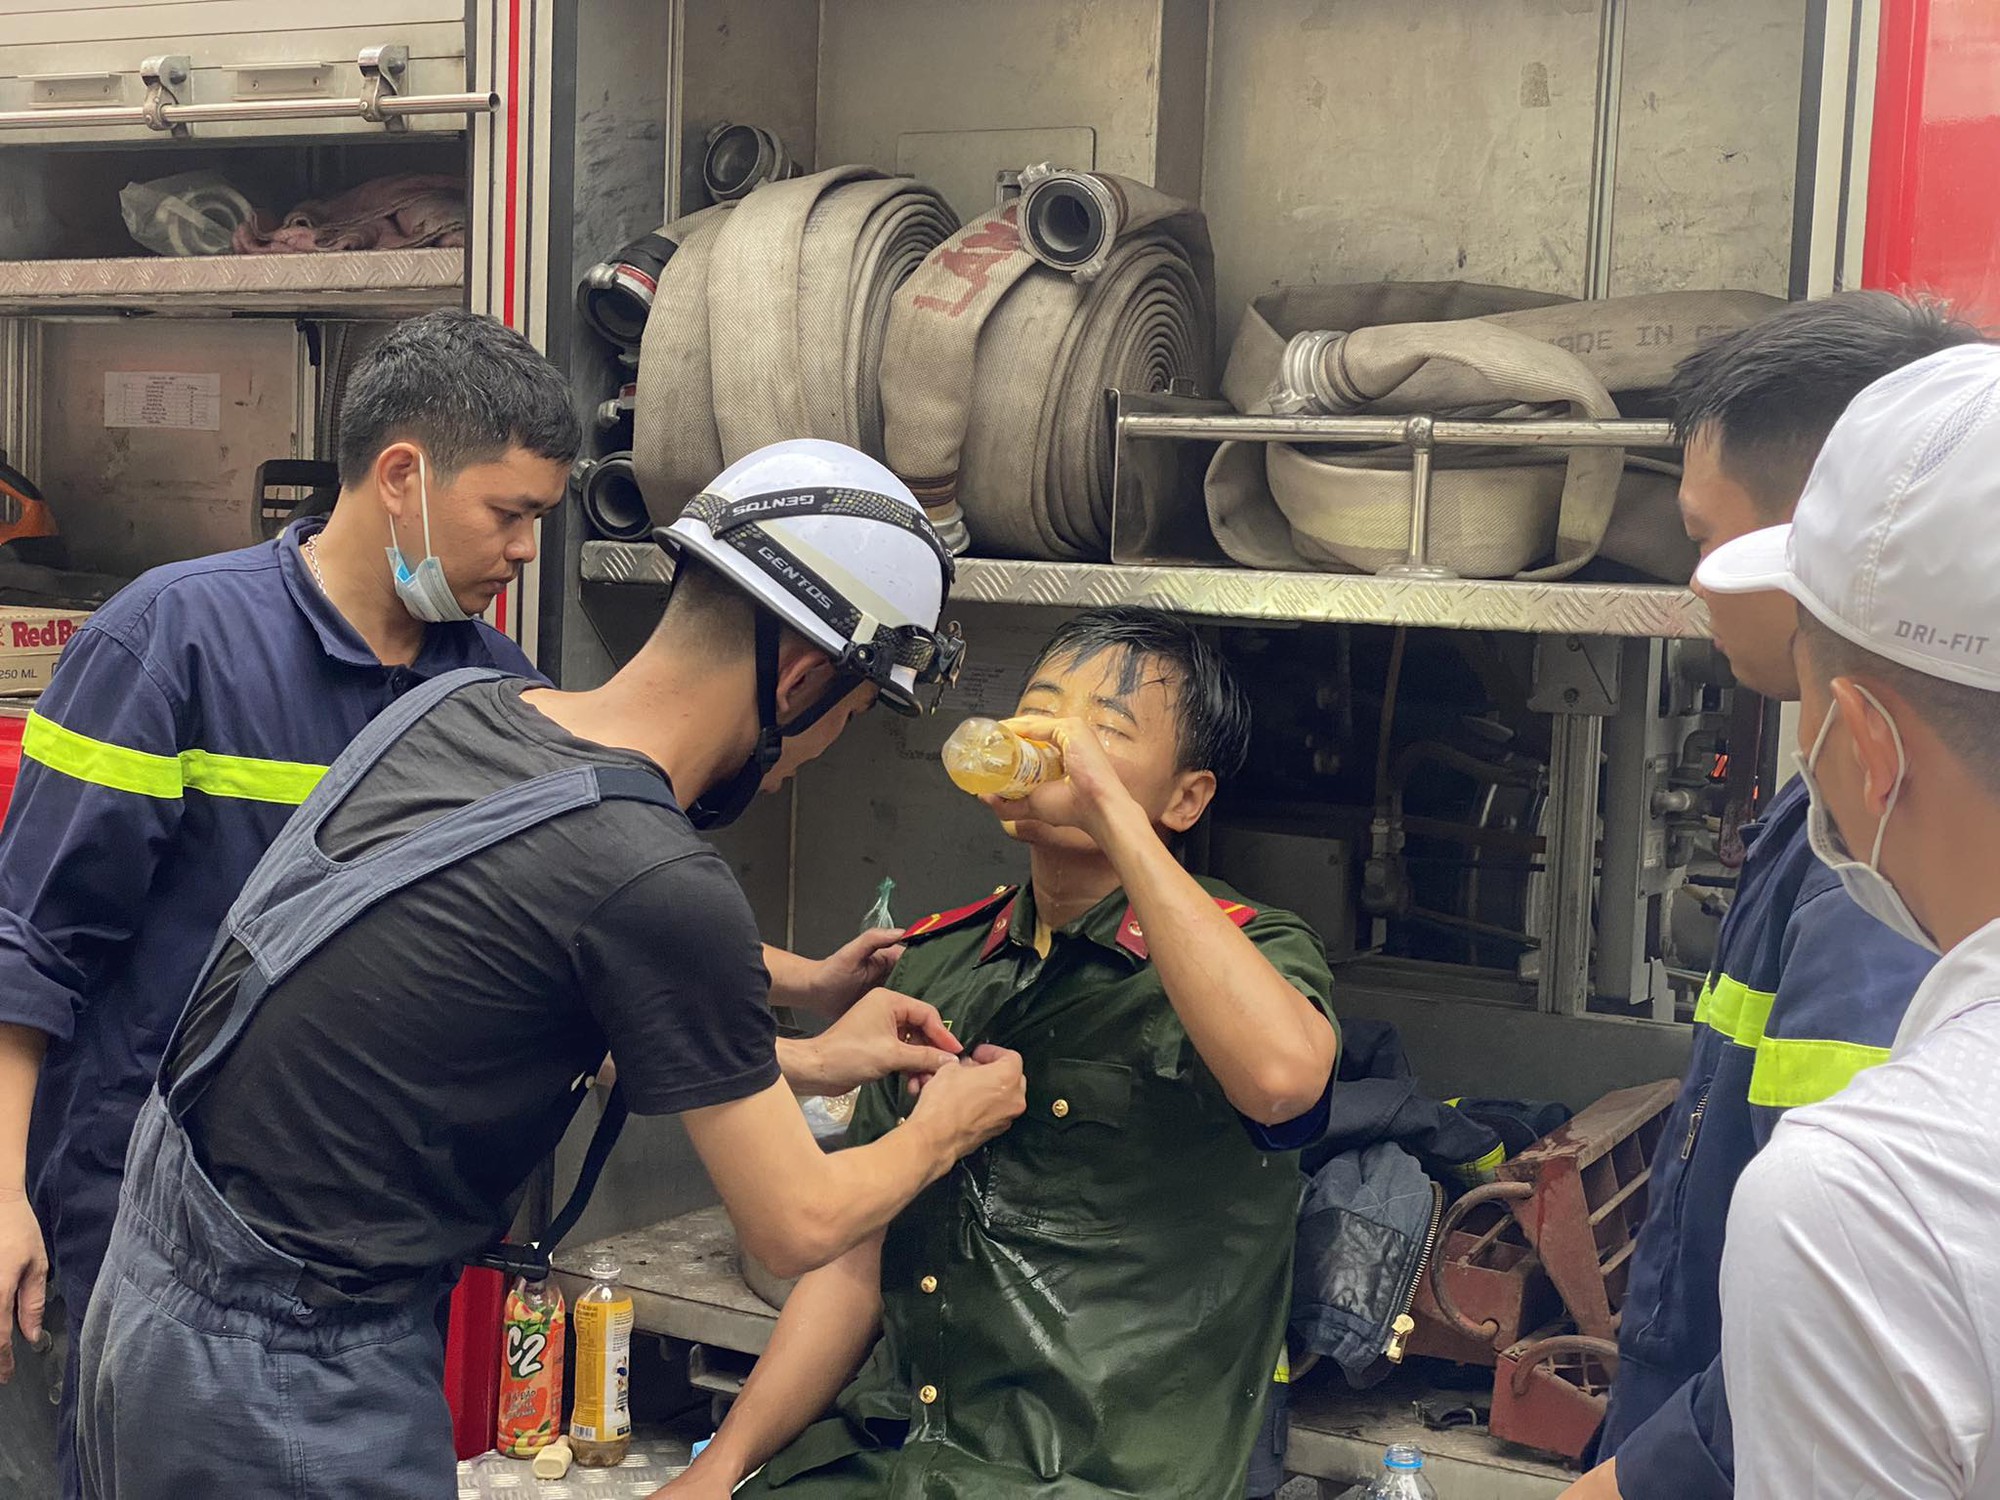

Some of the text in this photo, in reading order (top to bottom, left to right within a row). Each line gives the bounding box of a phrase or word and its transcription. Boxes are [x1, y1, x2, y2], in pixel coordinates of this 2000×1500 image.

[1547, 330, 1613, 353] ADE
[1636, 324, 1674, 347] IN
[732, 494, 815, 517] GENTOS
[758, 545, 834, 610] GENTOS
[1894, 619, 1990, 655] DRI-FIT
[21, 668, 37, 679] ML
[507, 1326, 546, 1377] C2
